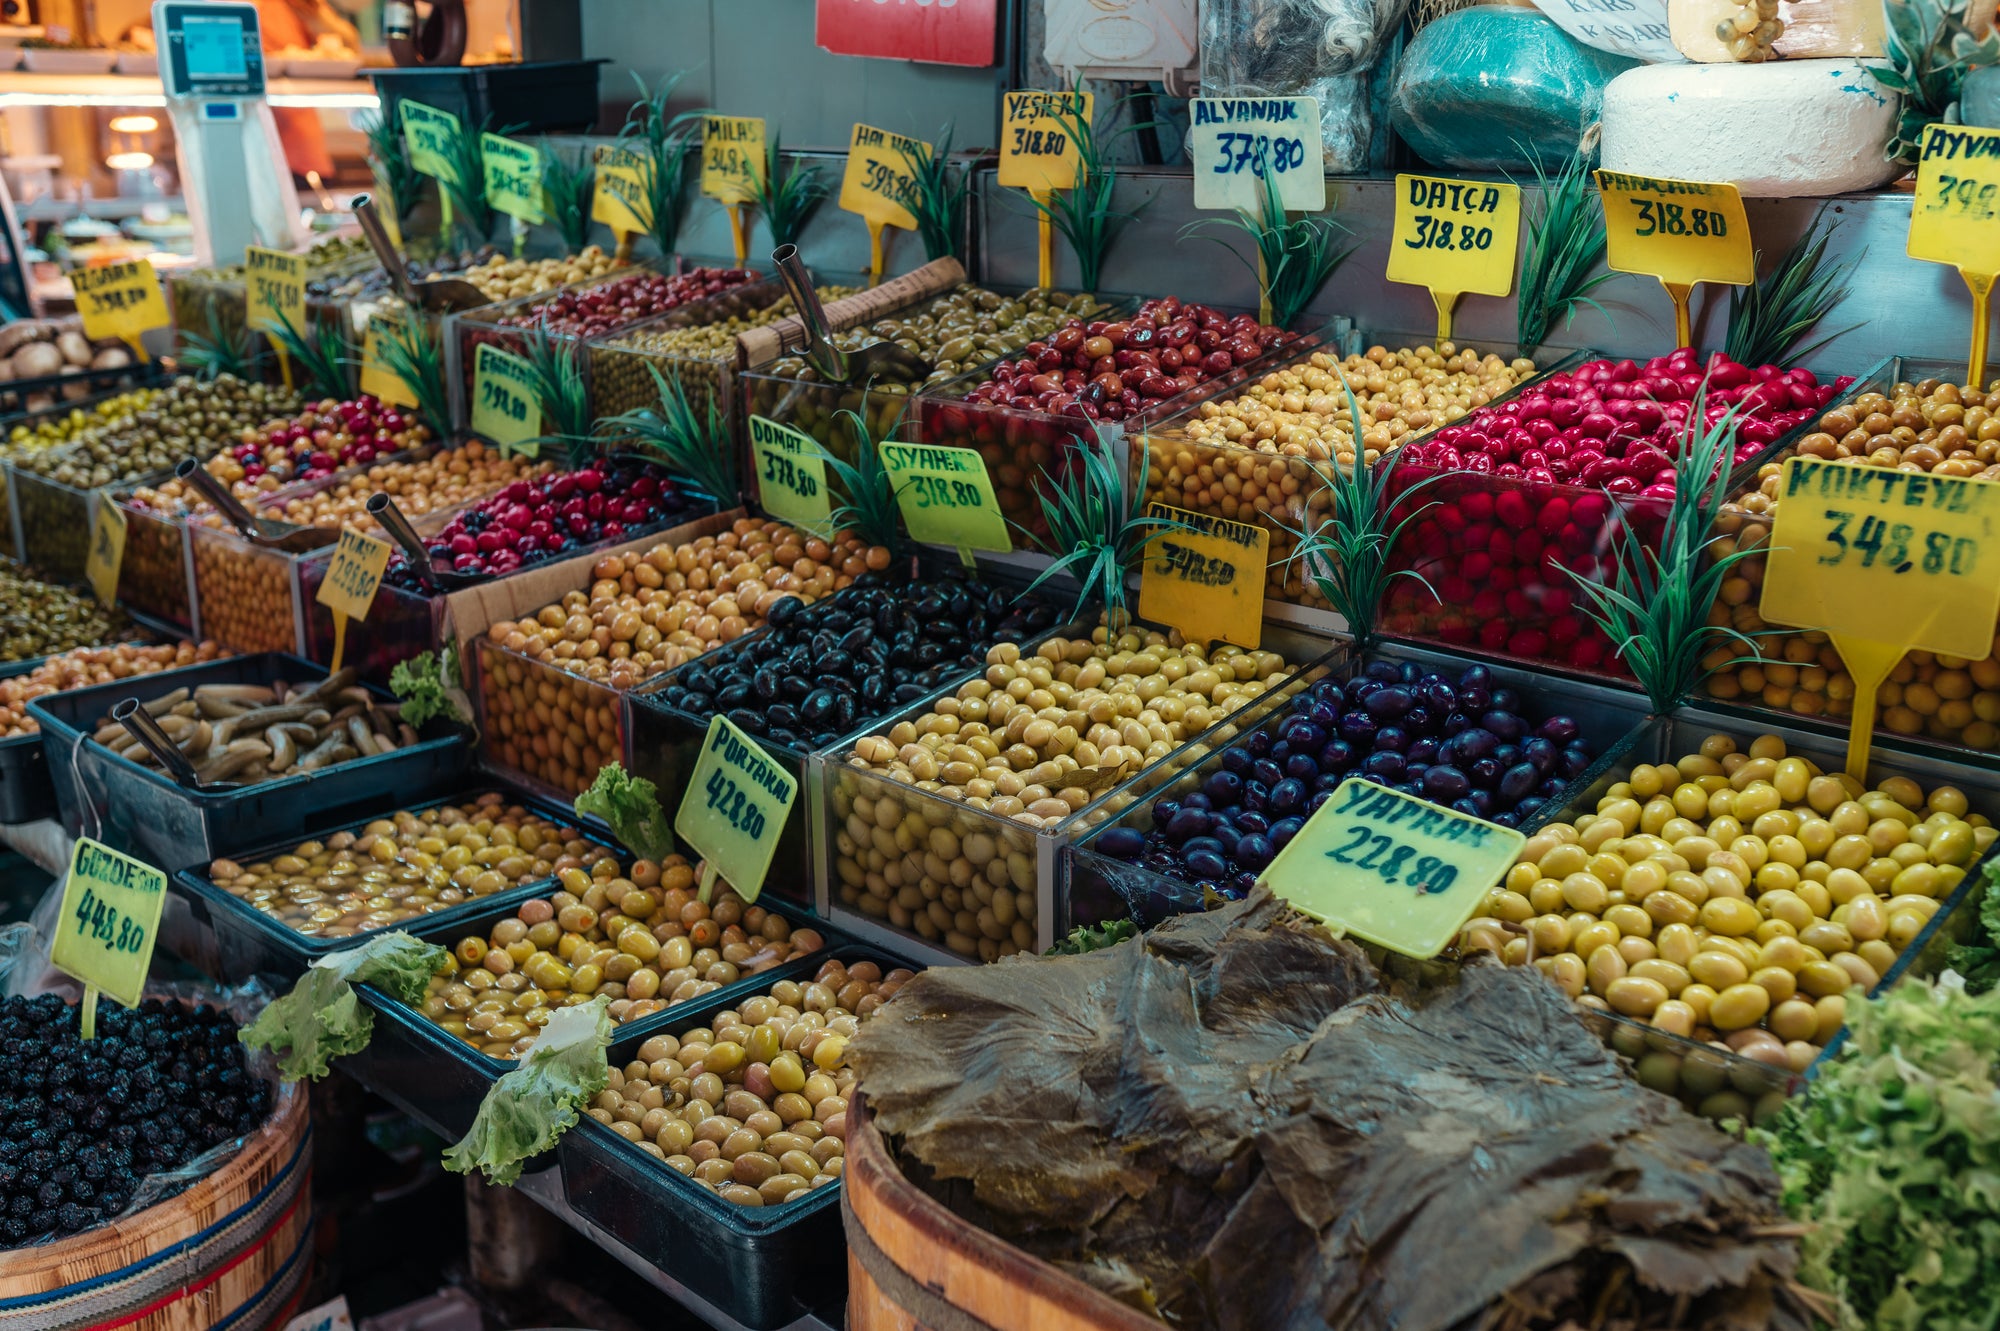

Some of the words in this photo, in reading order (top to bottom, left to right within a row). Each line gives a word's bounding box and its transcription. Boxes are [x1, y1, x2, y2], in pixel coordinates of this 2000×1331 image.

[1195, 100, 1299, 125] ALYANAK
[1409, 179, 1500, 215] DATÇA
[752, 418, 802, 454] DOMAT
[710, 722, 791, 805] PORTAKAL
